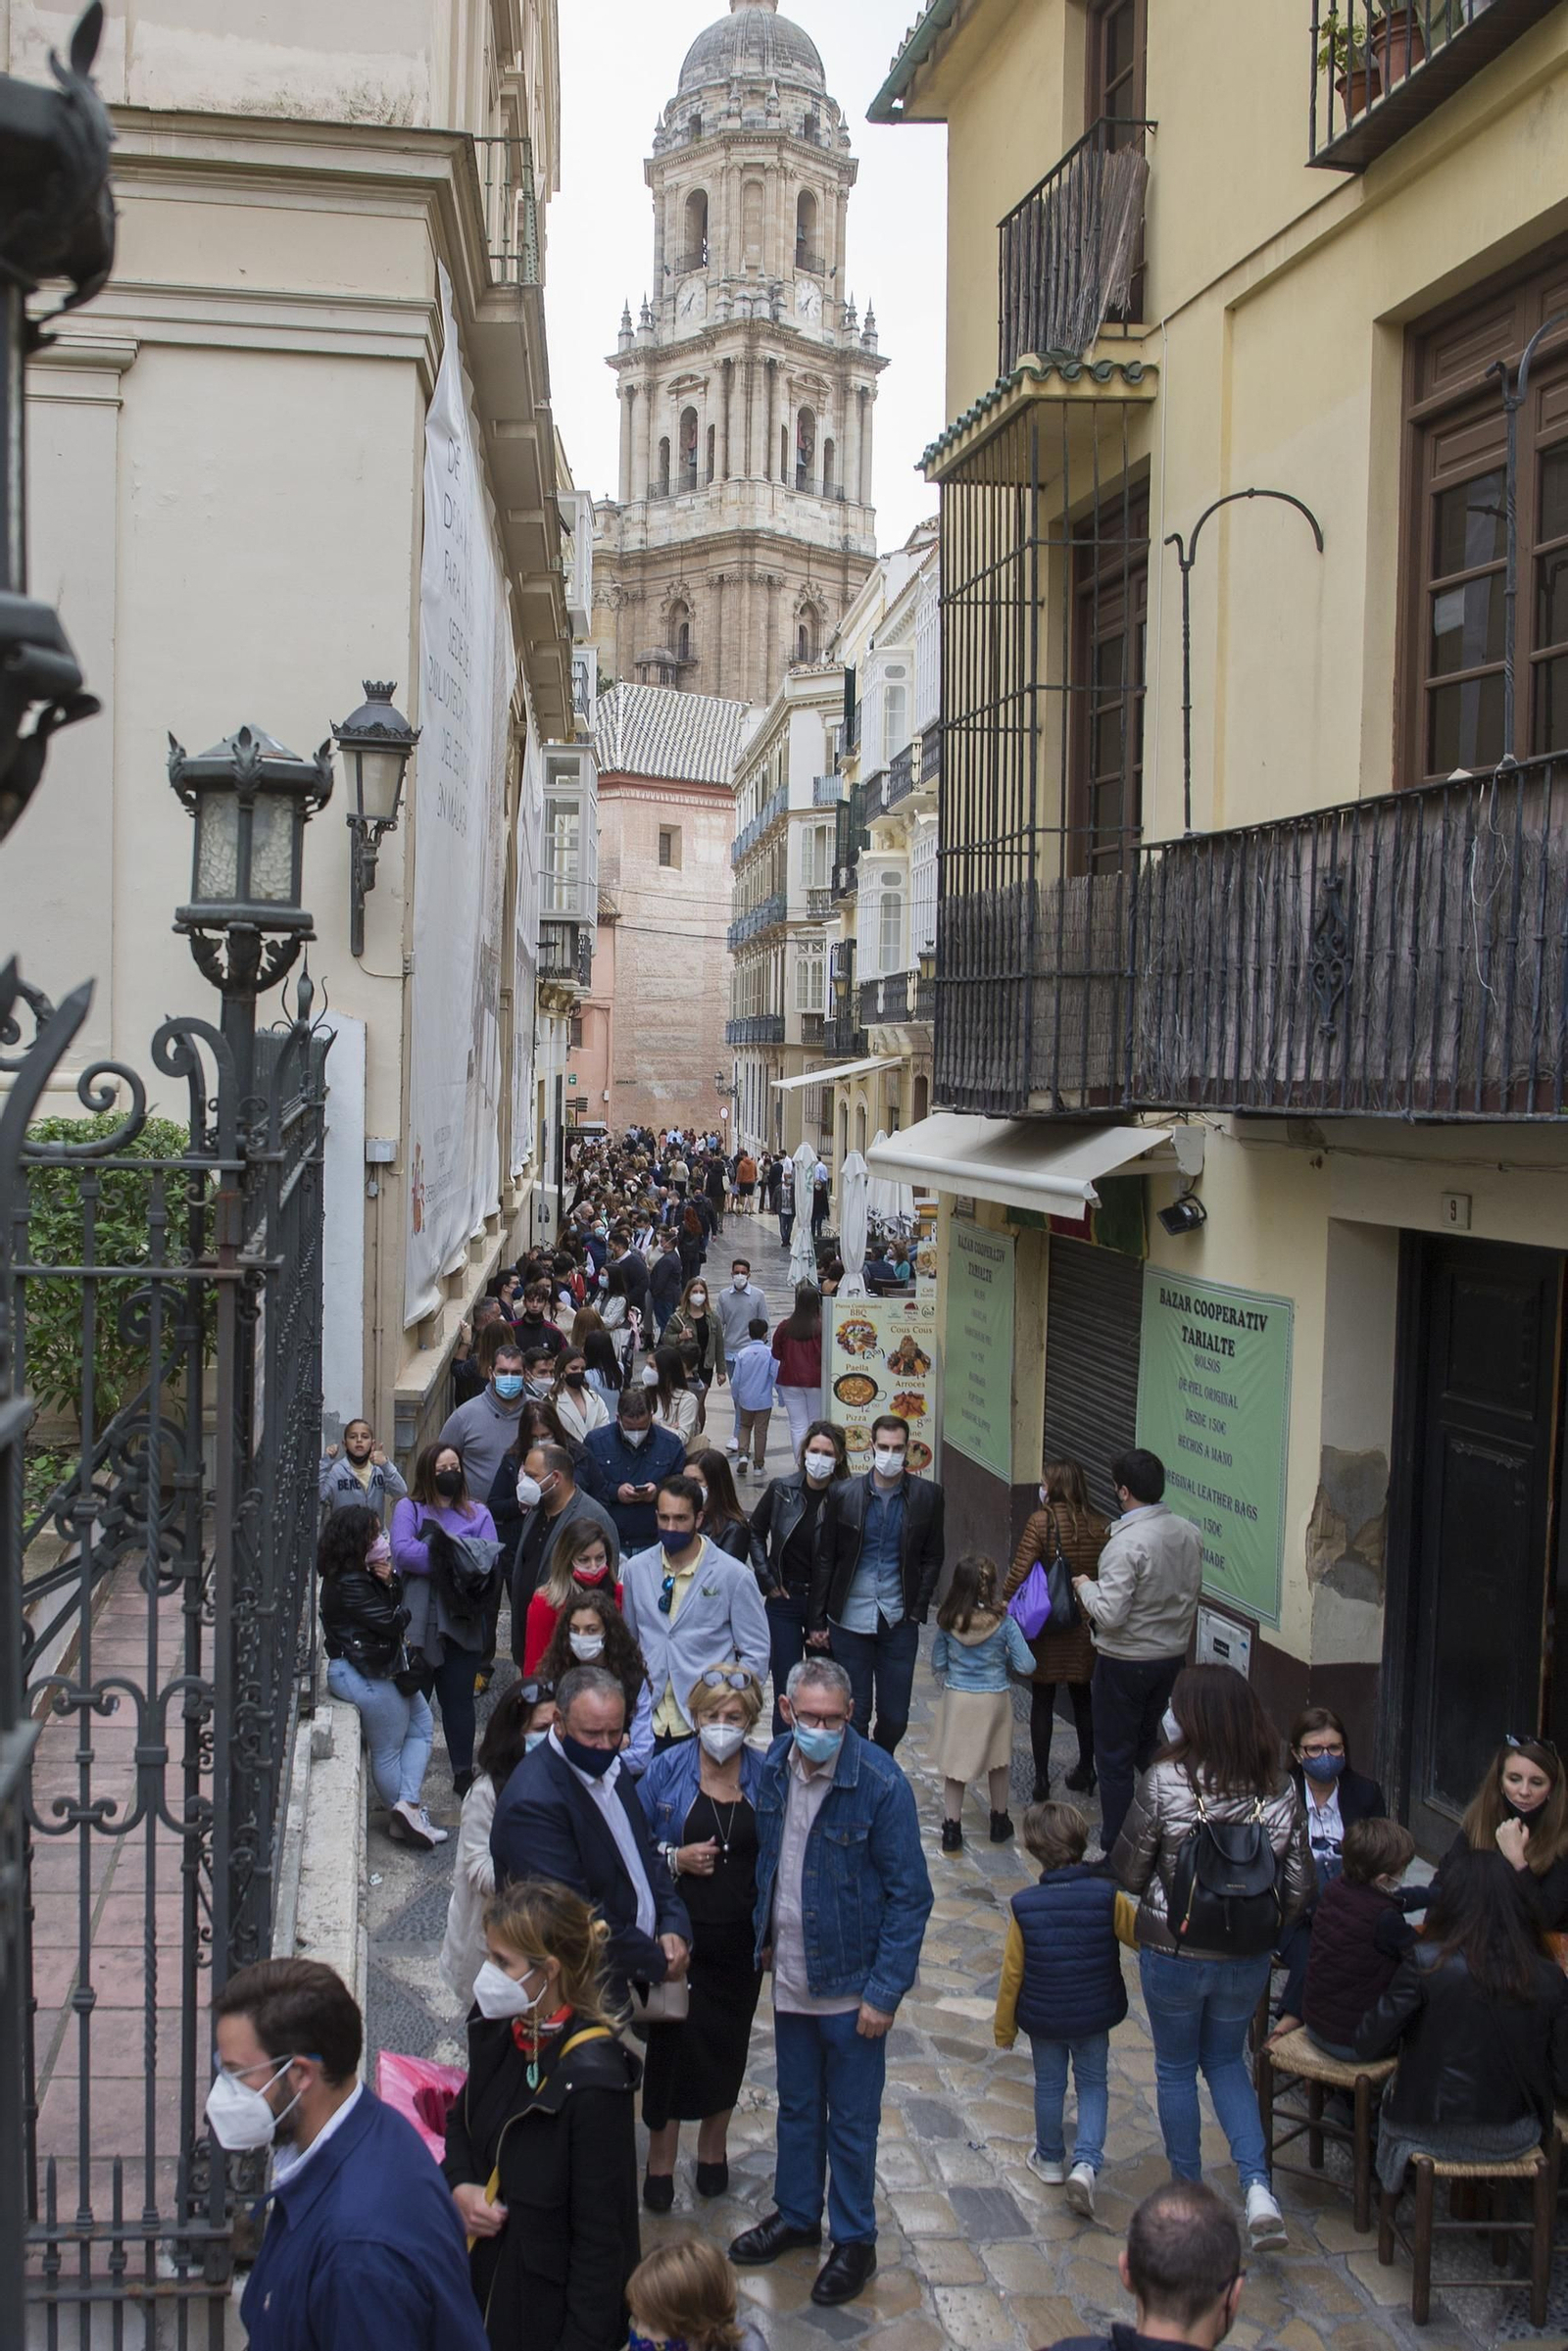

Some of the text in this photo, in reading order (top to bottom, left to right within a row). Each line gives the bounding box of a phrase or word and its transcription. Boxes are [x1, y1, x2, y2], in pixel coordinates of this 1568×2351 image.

[1450, 1200, 1457, 1222] 9
[1159, 1288, 1269, 1333] BAZAR COOPERATIV
[1182, 1326, 1236, 1357] TARIALTE
[846, 1363, 869, 1372] Paella
[1194, 1354, 1221, 1374] BOLSOS
[1178, 1377, 1189, 1391] DE
[1204, 1386, 1239, 1409] ORIGINAL
[846, 1413, 867, 1422] Pizza
[1186, 1408, 1227, 1436] DESDE 150€
[1178, 1434, 1233, 1468] HECHOS A MANO
[1164, 1470, 1258, 1520] REGINAL LEATHER BAGS
[1203, 1517, 1223, 1538] 150€
